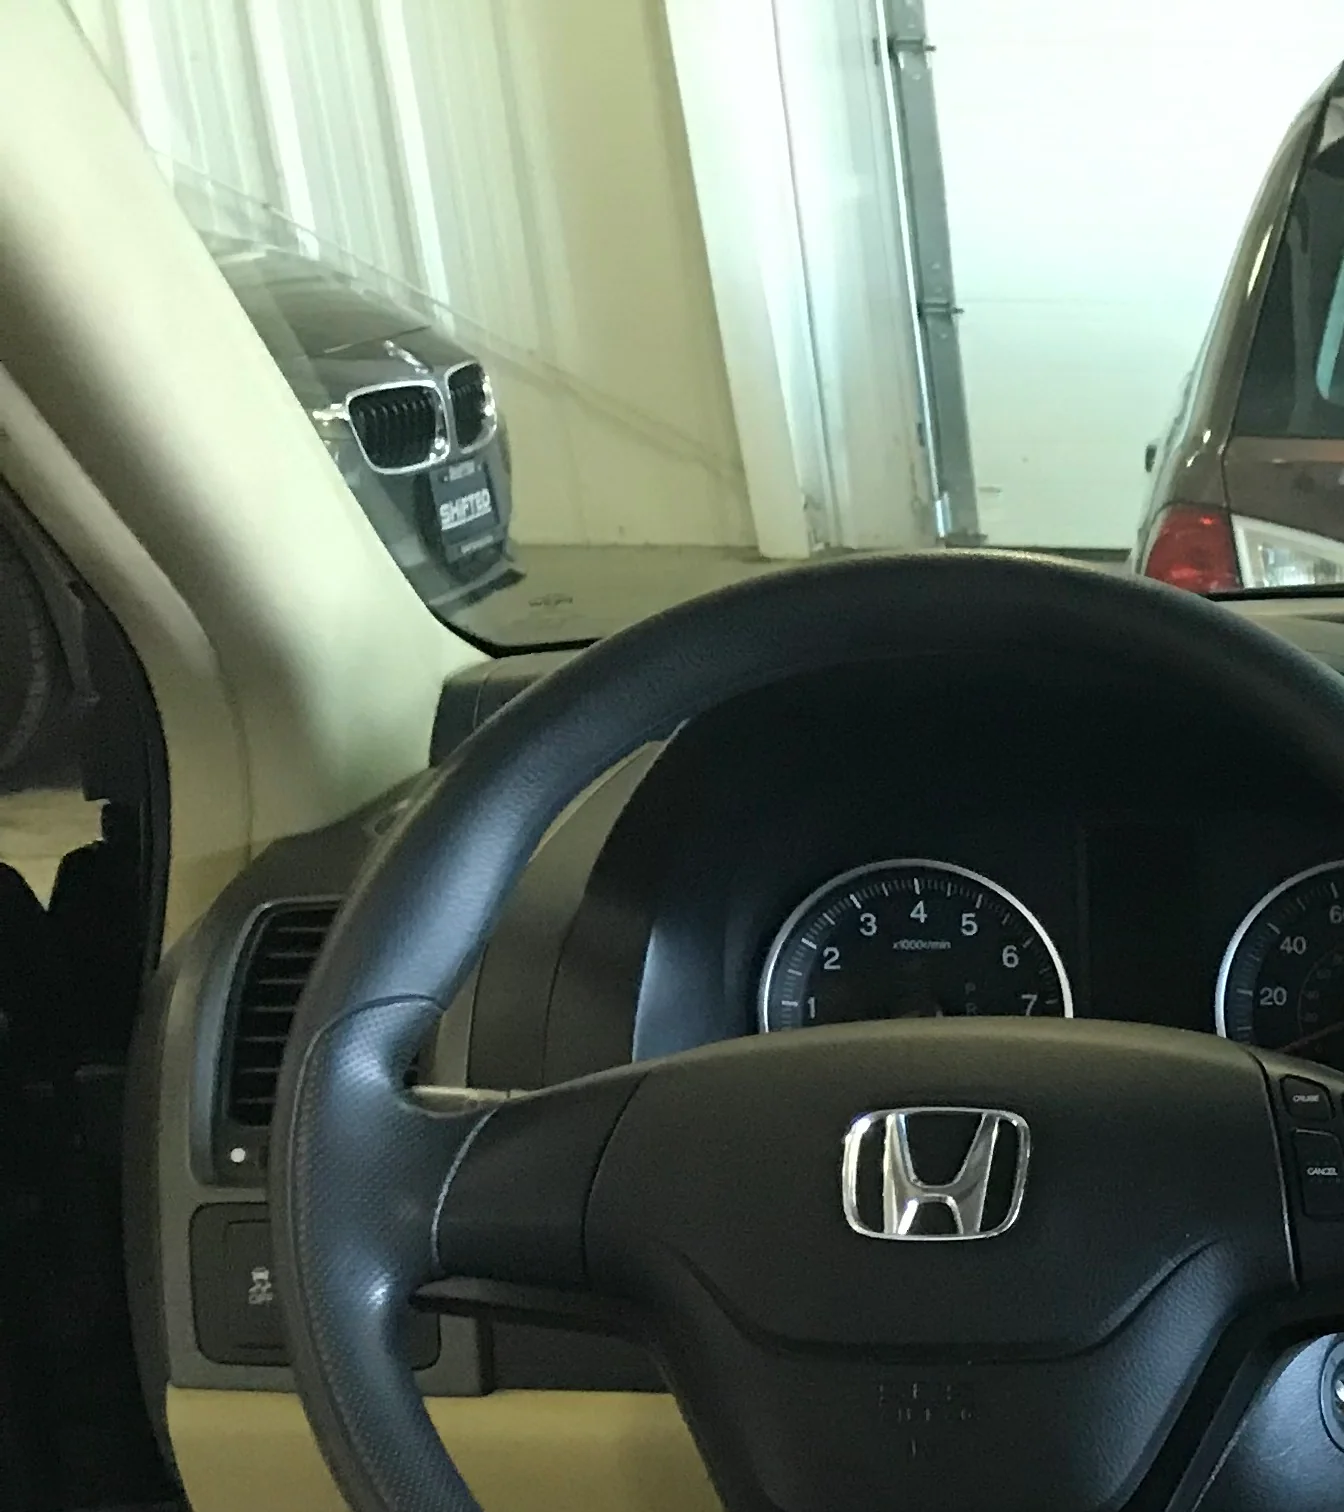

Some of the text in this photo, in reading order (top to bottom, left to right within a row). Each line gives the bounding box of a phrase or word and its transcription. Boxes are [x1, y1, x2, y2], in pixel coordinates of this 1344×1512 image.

[910, 900, 928, 923] 4
[859, 912, 877, 936] 3
[960, 912, 979, 936] 5
[822, 946, 841, 970] 2
[1001, 945, 1020, 969] 6
[1279, 936, 1307, 956] 40
[806, 996, 817, 1020] 1
[1020, 993, 1039, 1017] 7
[1259, 987, 1288, 1006] 20
